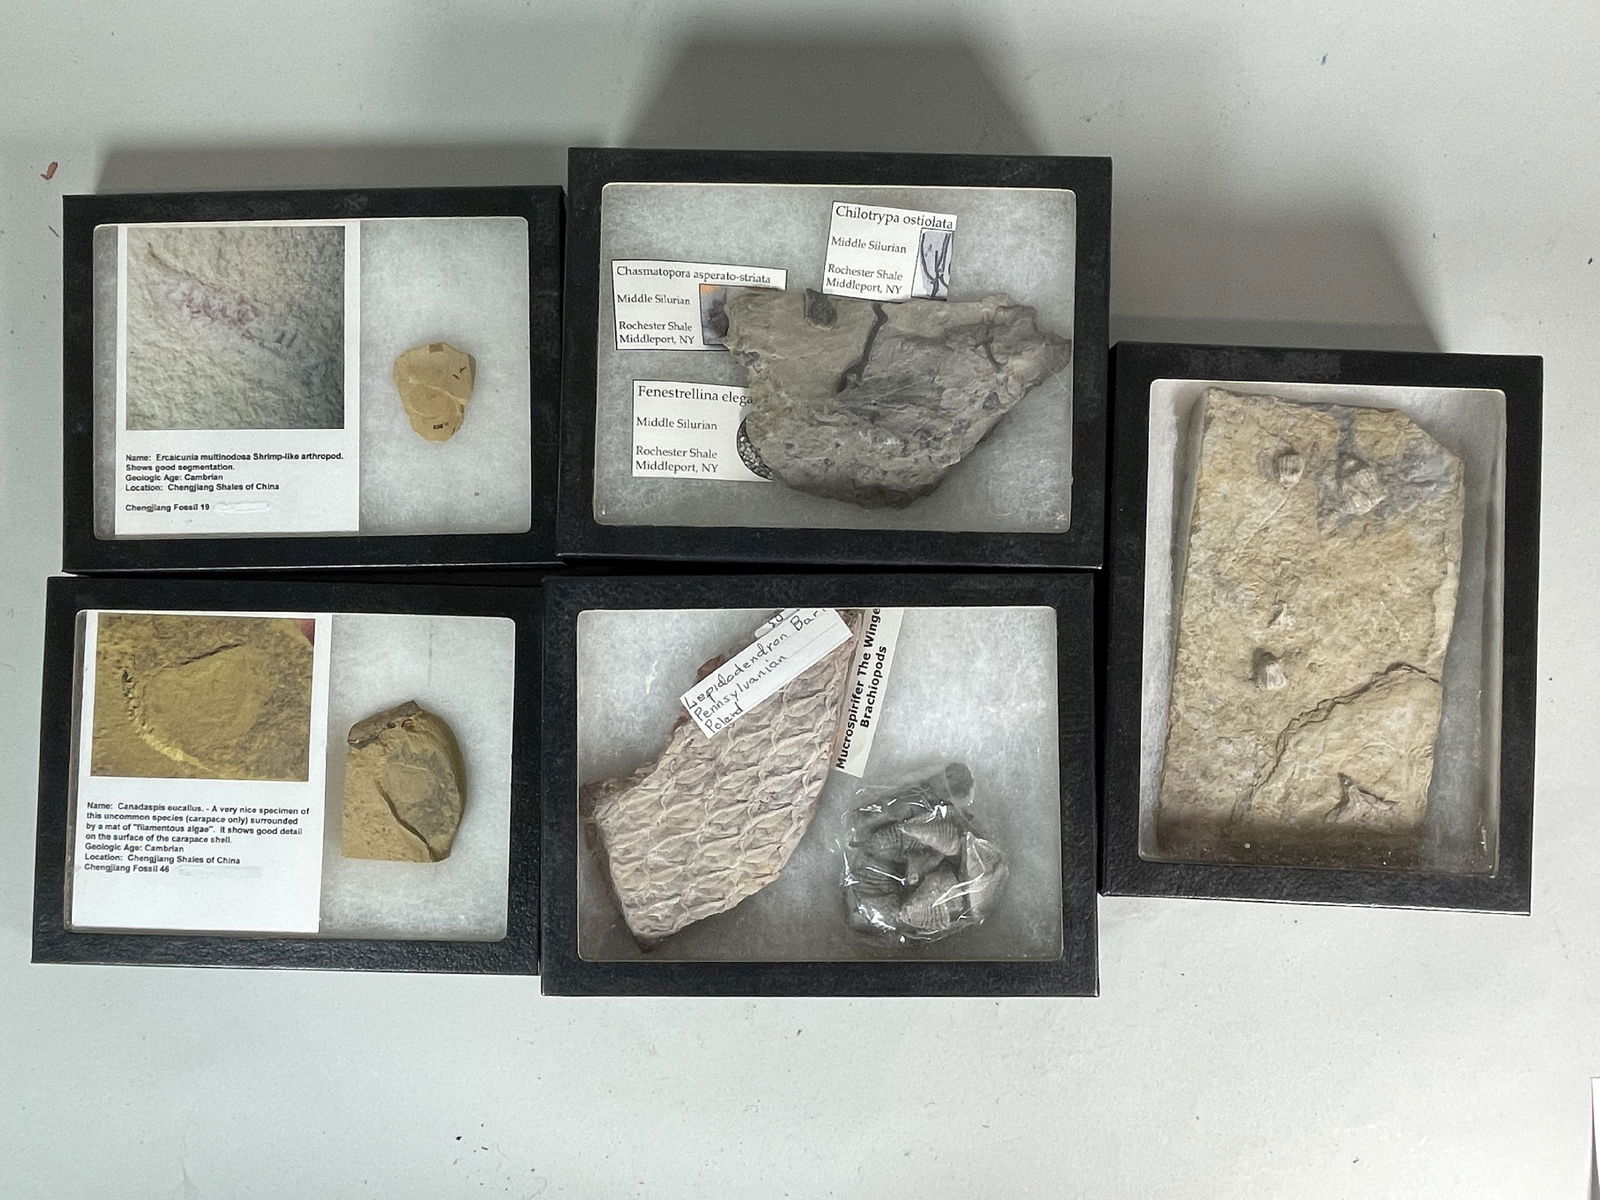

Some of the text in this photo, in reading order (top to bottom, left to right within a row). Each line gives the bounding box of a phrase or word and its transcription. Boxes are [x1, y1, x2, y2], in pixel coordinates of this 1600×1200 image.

[836, 205, 953, 229] Chilotrypa ostiolata
[831, 236, 906, 253] Middle Silurian
[617, 266, 771, 284] Chasmatopora asperato-striata
[828, 264, 903, 281] Rochester Shale
[826, 278, 903, 294] Middleport, NY
[617, 294, 690, 305] Middle Silurian
[619, 321, 692, 332] Rochester Shale
[619, 334, 695, 346] Middleport, NY
[638, 385, 719, 401] Fenestrellina
[636, 417, 718, 430] Middle Silurian
[253, 453, 299, 461] Shrimp-like
[301, 453, 343, 461] arthropod.
[636, 445, 718, 459] Rochester Shale
[155, 464, 175, 472] good
[178, 464, 235, 472] segmentation.
[636, 461, 718, 474] Middleport, NY
[164, 474, 182, 482] Age:
[168, 484, 214, 492] Chengjiang
[125, 504, 171, 512] Chengjiang
[694, 656, 787, 721] Pennsylvanian
[860, 646, 887, 728] Brachiopods
[836, 681, 864, 770] Mucrospirifer
[856, 652, 871, 678] The
[705, 702, 743, 733] Poland
[118, 802, 165, 812] Canadaspis
[152, 814, 183, 822] species
[186, 815, 225, 823] (carapace
[228, 817, 248, 825] only)
[85, 842, 121, 852] Geologic
[124, 844, 142, 852] Age:
[127, 854, 174, 864] Chengjiang
[84, 863, 130, 873] Chengjiang
